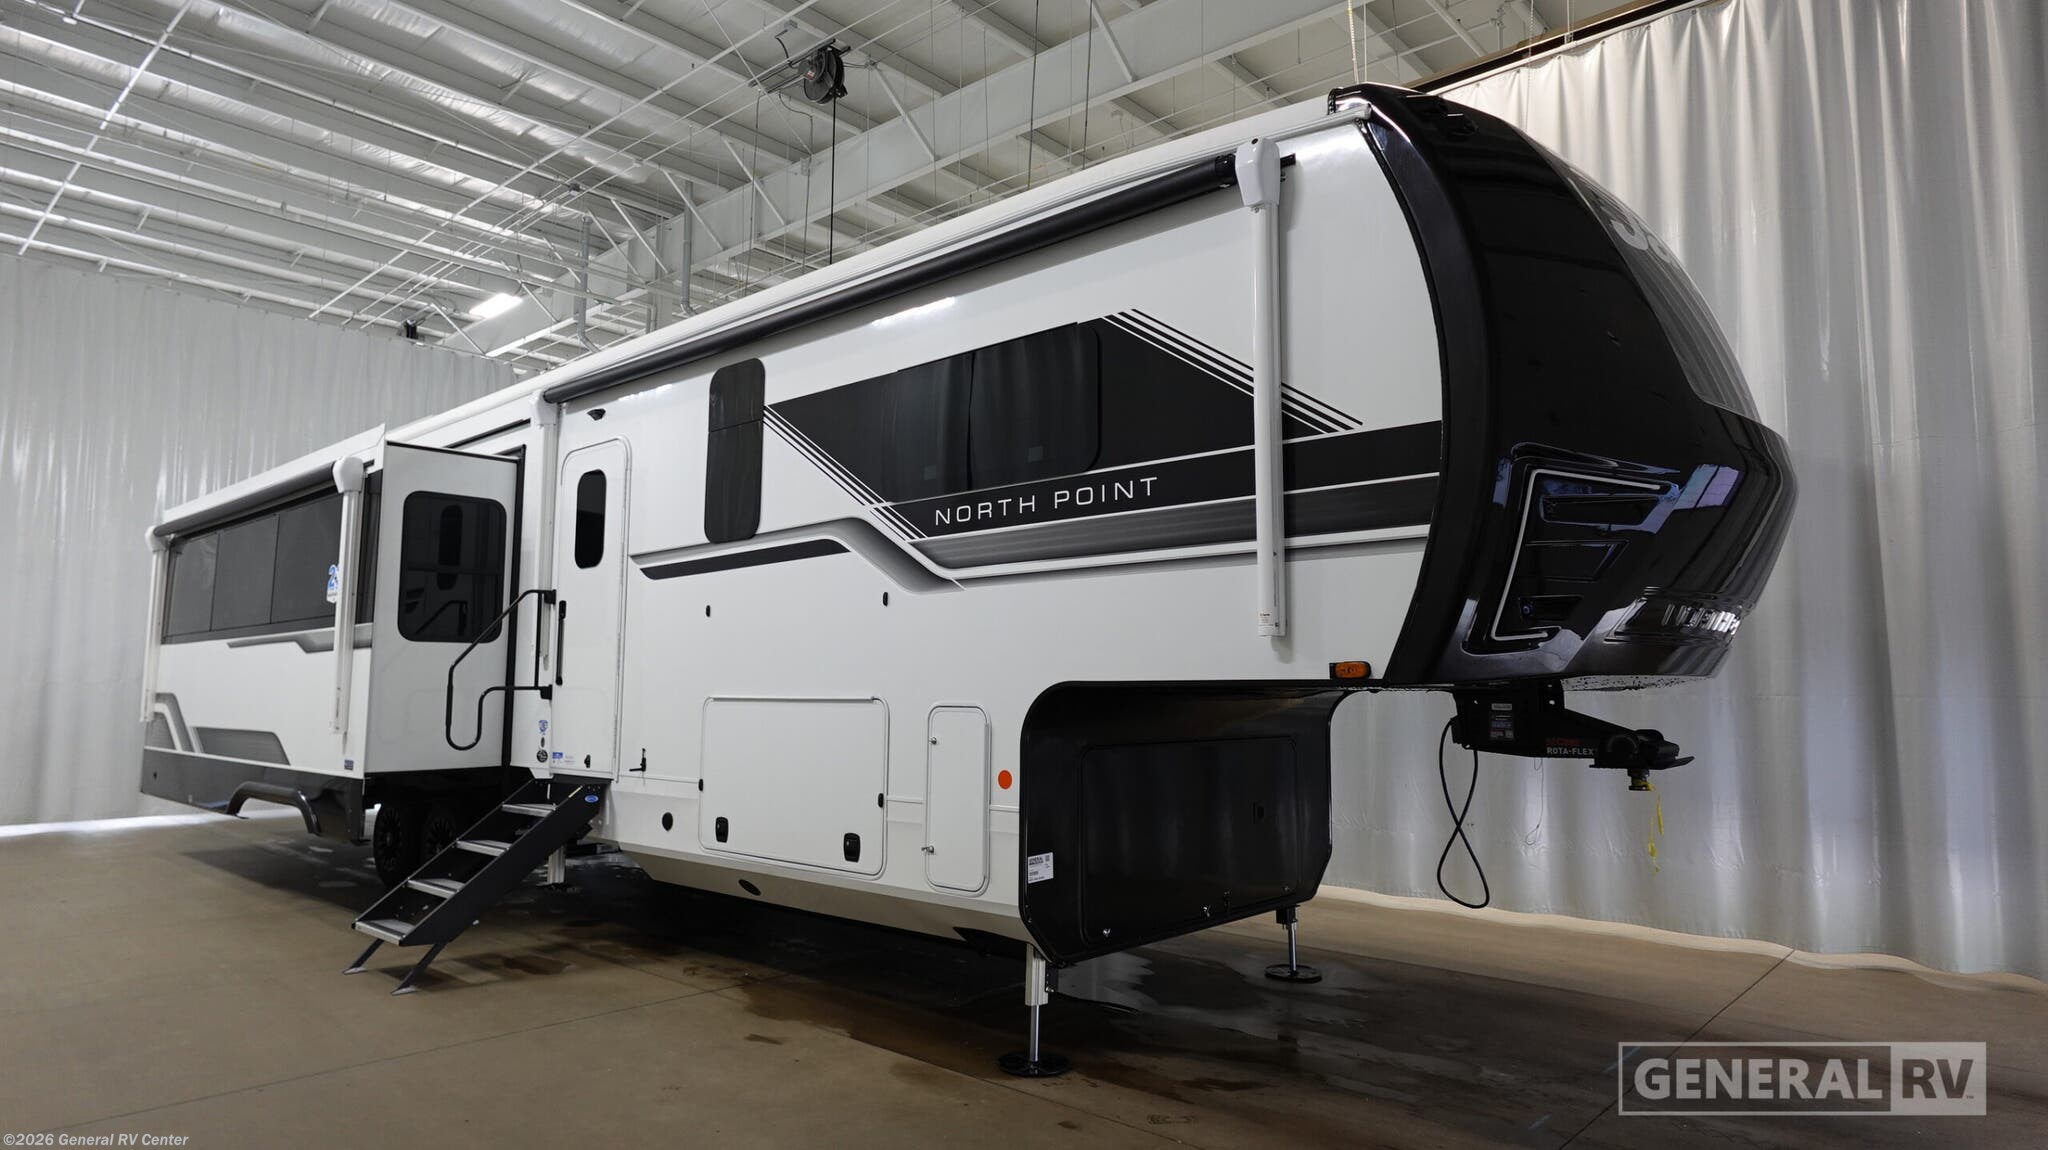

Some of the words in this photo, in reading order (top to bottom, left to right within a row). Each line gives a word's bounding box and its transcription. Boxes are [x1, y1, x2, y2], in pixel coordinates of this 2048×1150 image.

[935, 495, 1036, 526] NORTH
[1054, 477, 1158, 509] POINT
[1546, 747, 1594, 756] ROTA-FLEX
